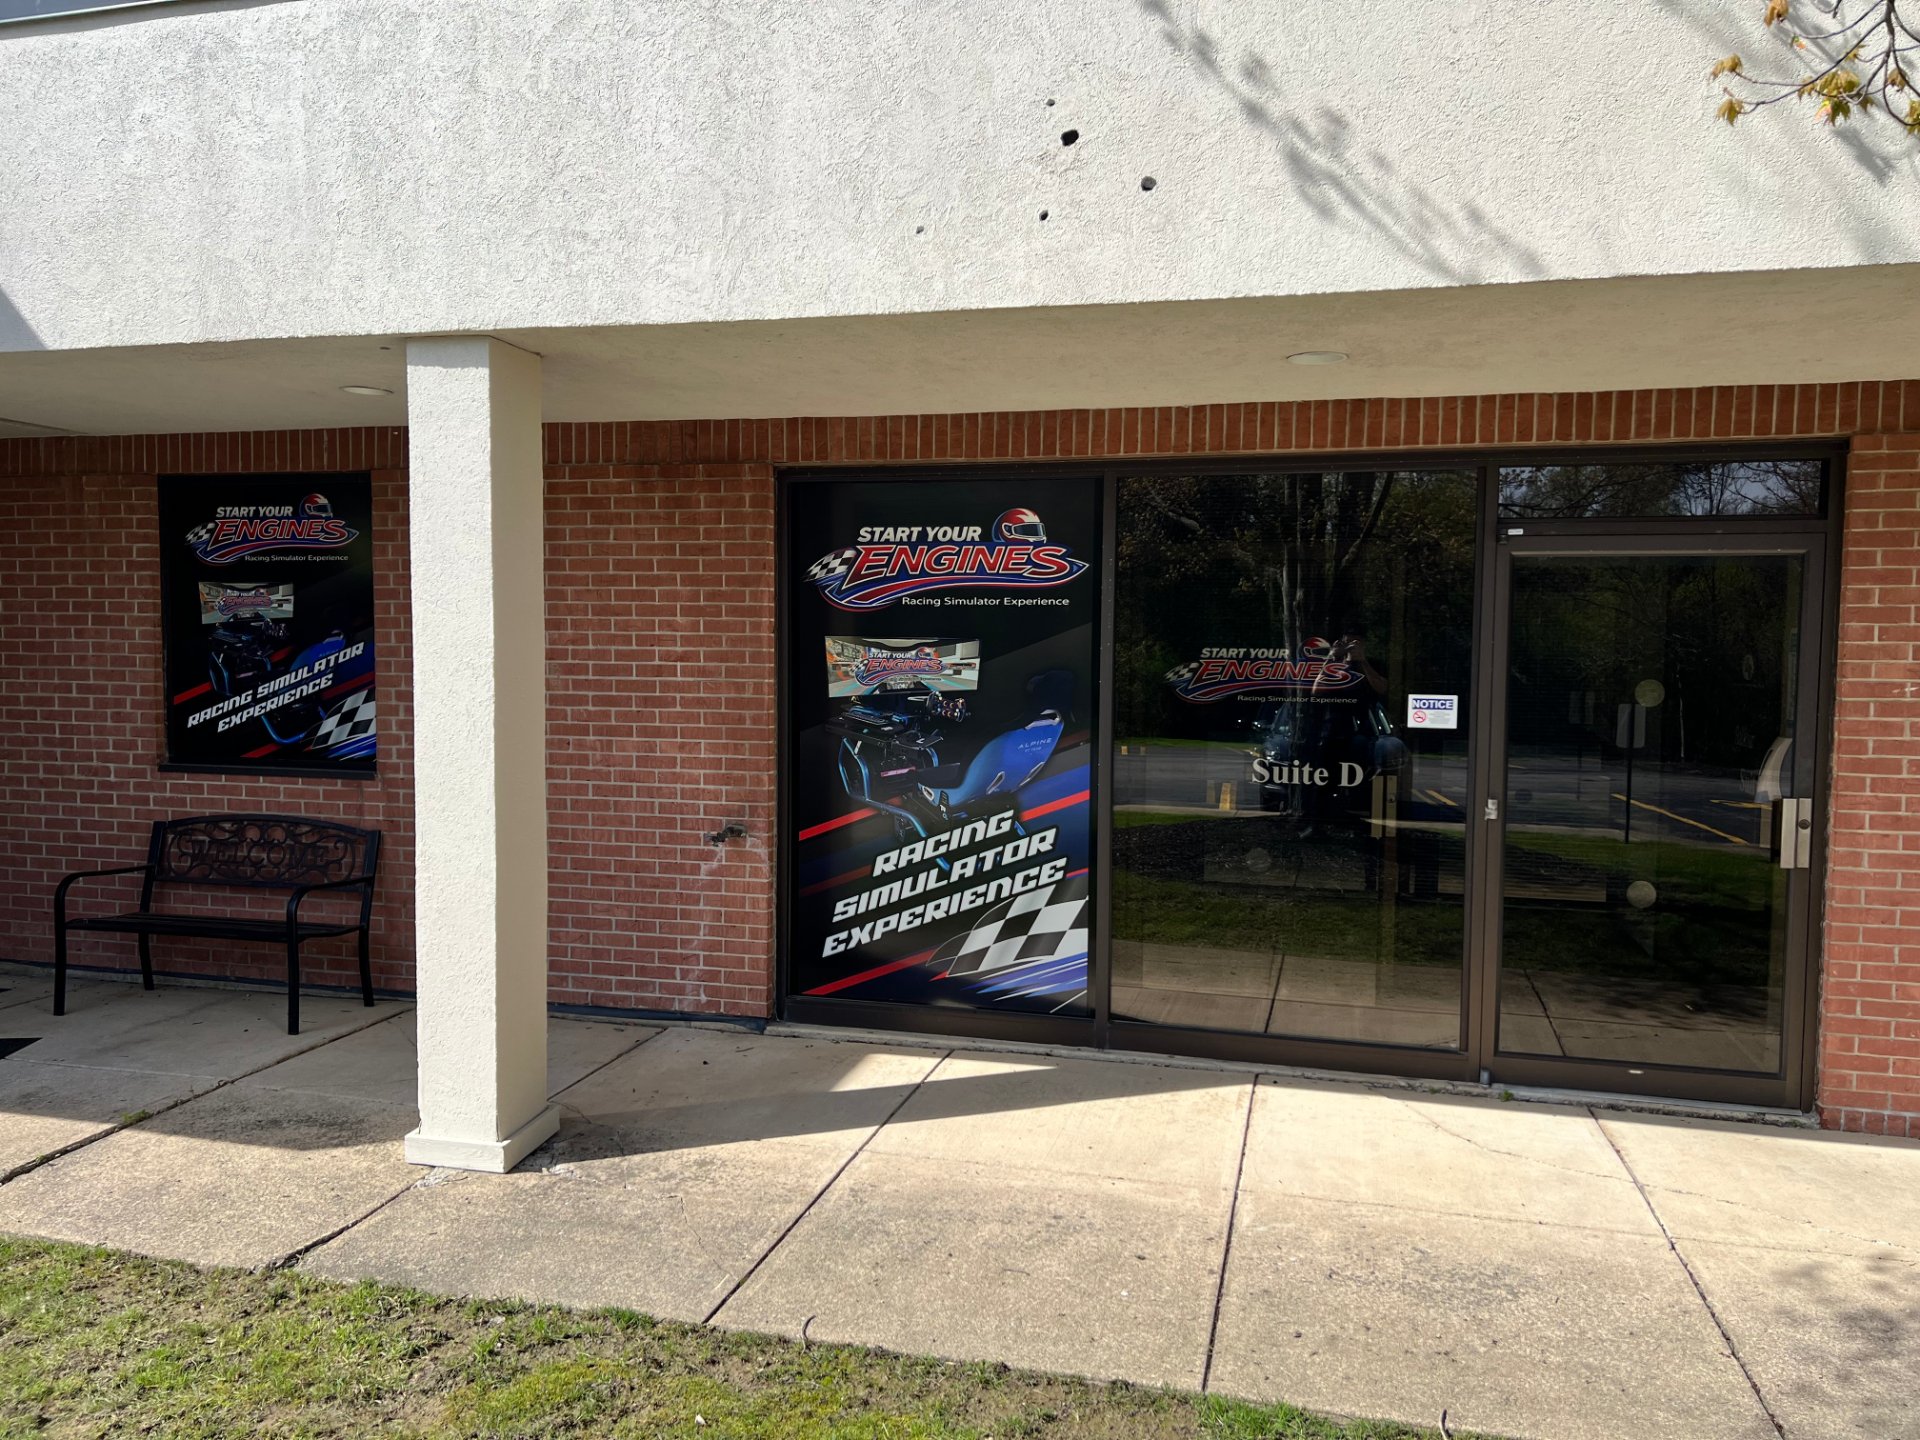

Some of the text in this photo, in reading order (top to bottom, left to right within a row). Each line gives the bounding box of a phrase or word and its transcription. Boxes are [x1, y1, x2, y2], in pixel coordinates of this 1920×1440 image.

[215, 505, 294, 519] START YOUR
[207, 518, 354, 550] ENGINES
[857, 525, 982, 543] START YOUR
[244, 554, 349, 563] Racing Simulator Experience
[842, 545, 1072, 590] ENGINES
[901, 596, 1070, 608] Racing Simulator Experience
[1200, 647, 1290, 660] START YOUR
[187, 641, 366, 728] RACING SIMULATOR
[1188, 659, 1351, 688] ENGINES
[217, 673, 334, 733] EXPERIENCE
[1237, 694, 1358, 705] Racing Simulator Experience
[1411, 699, 1453, 709] NOTICE
[1251, 758, 1364, 787] Suite D
[189, 838, 330, 868] WELCOME
[872, 809, 1014, 877] RACING
[832, 827, 1058, 923] SIMULATOR
[822, 857, 1068, 958] EXPERIENCE
